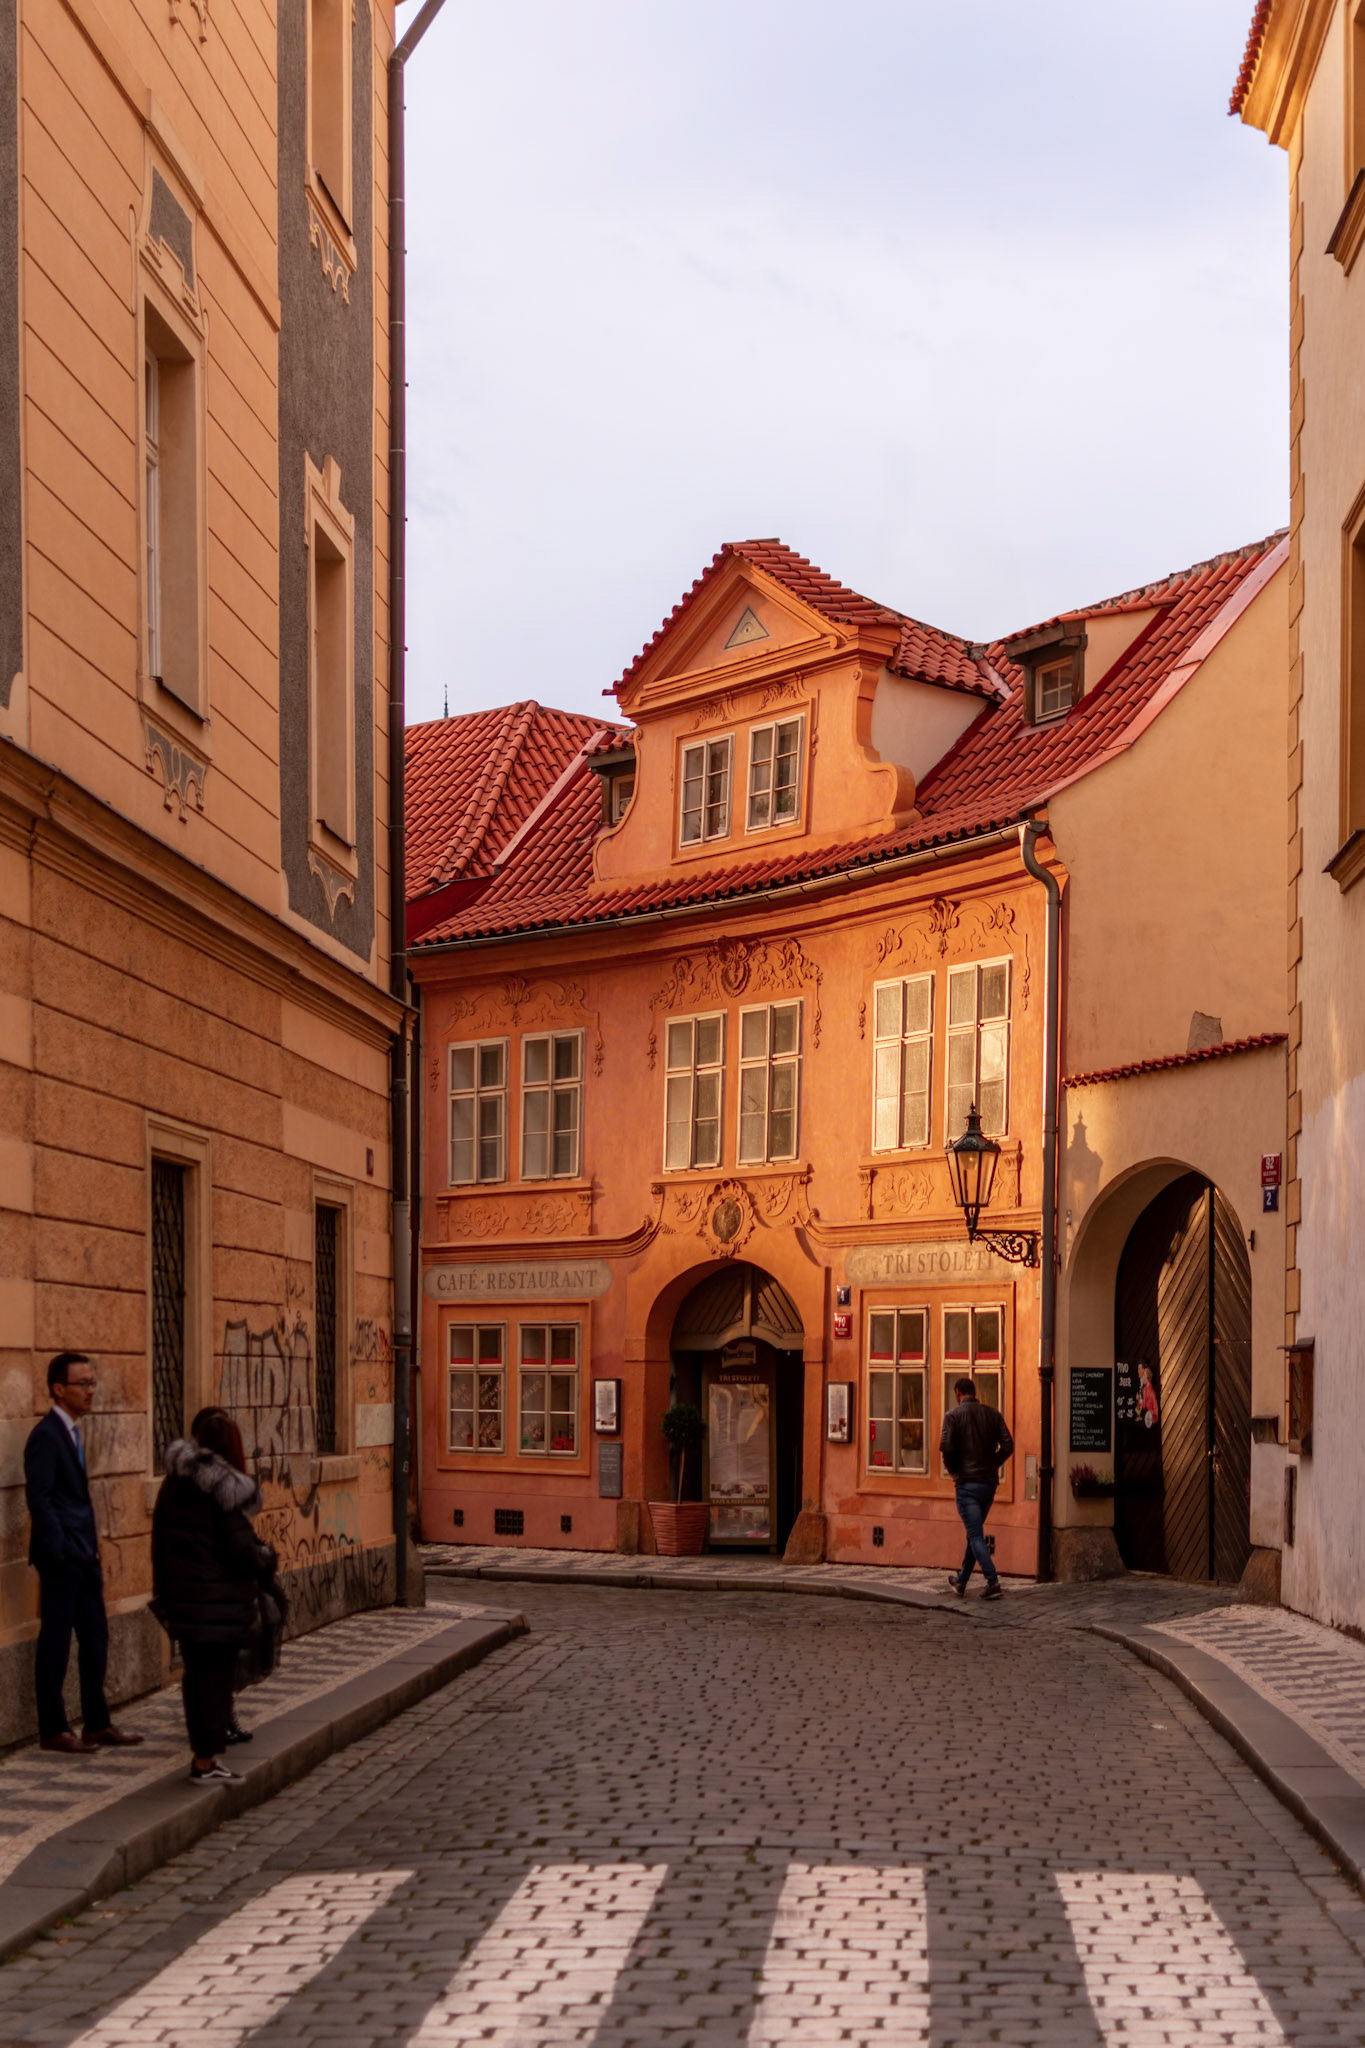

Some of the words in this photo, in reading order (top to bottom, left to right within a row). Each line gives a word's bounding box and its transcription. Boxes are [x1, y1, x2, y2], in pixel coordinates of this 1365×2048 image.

[1265, 1157, 1274, 1170] 92
[1266, 1192, 1272, 1206] 2
[437, 1269, 479, 1291] CAFÉ
[487, 1270, 598, 1290] RESTAURANT
[1116, 1362, 1129, 1373] PIVO
